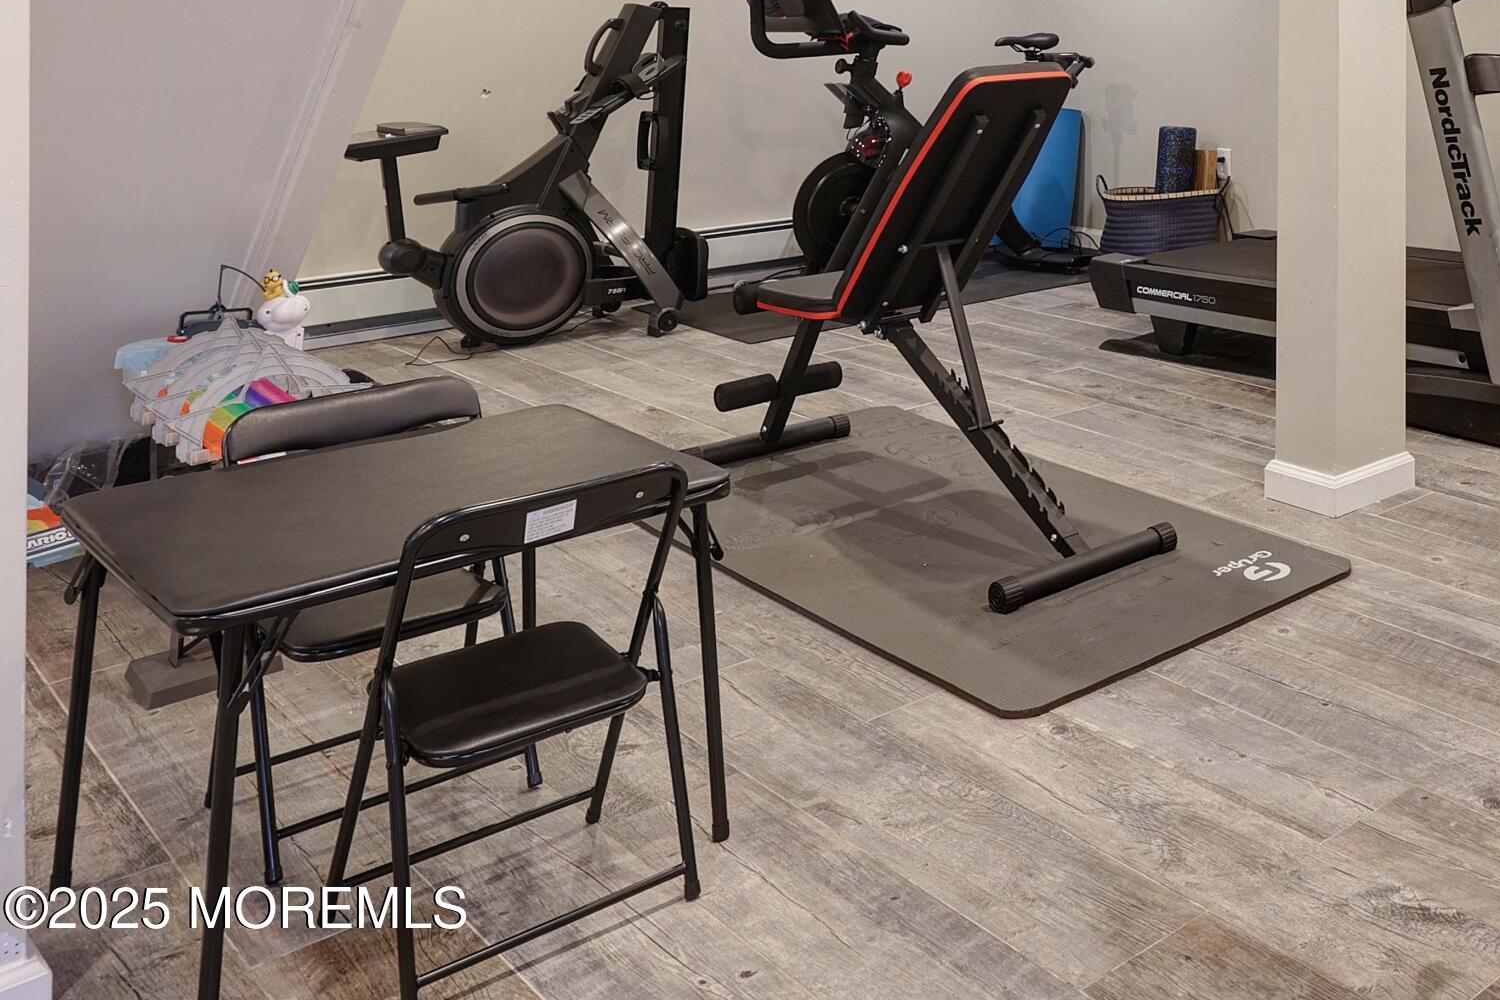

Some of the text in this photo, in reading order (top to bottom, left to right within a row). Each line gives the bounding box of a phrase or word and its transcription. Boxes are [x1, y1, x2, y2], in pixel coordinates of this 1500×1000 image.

[1429, 67, 1482, 237] NordicTrack
[1136, 286, 1216, 305] COMMERCIAL 1750
[27, 529, 68, 549] ARIO
